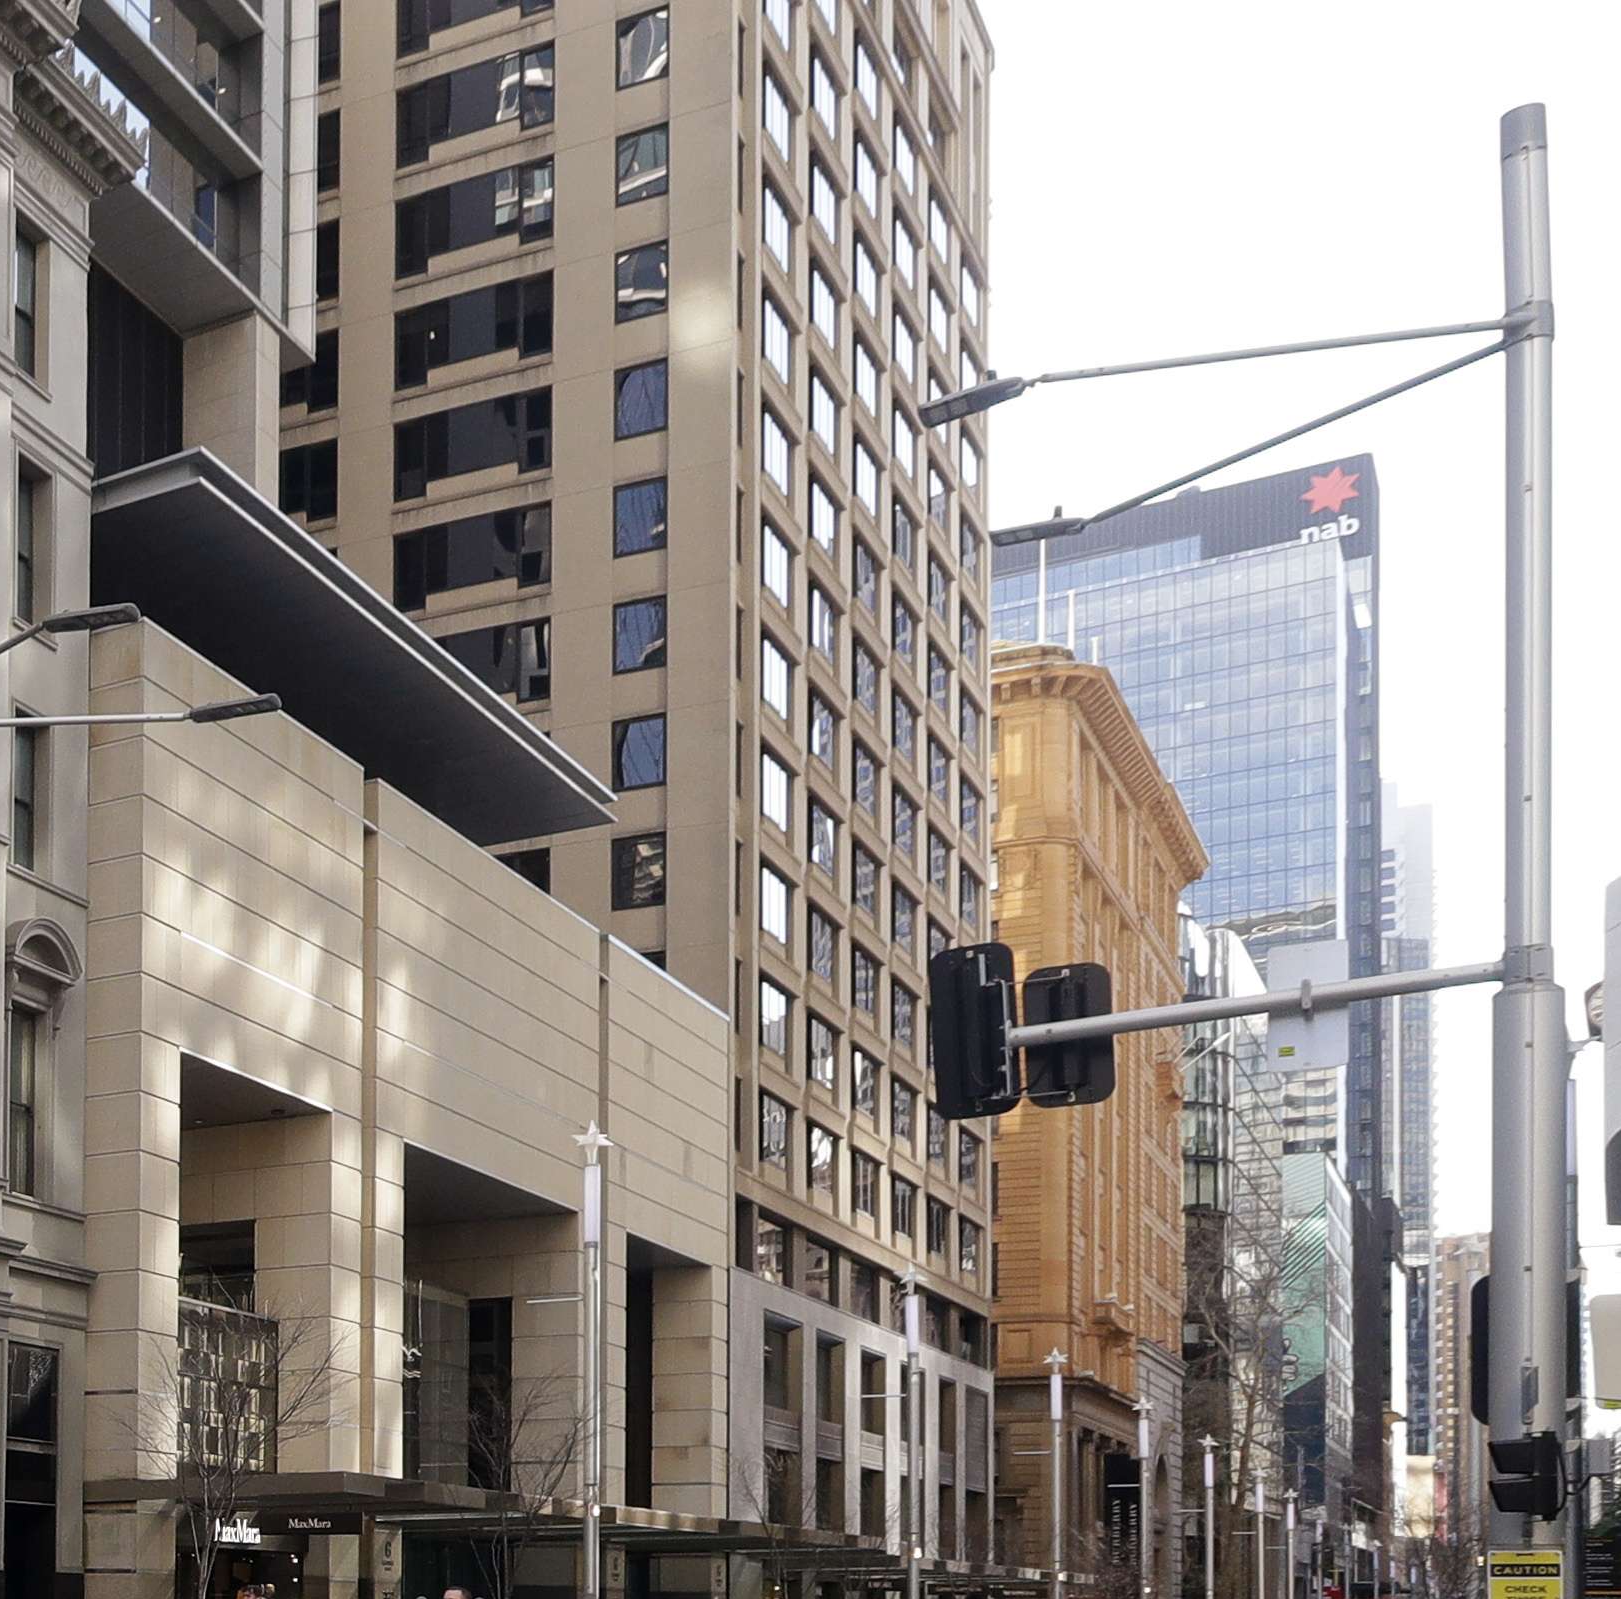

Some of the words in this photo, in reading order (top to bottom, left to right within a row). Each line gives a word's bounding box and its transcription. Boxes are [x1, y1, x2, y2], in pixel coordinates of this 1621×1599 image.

[1299, 513, 1360, 544] nab
[288, 1518, 332, 1529] MaxMara
[1493, 1566, 1558, 1575] CAUTION
[1504, 1585, 1547, 1594] CHECK
